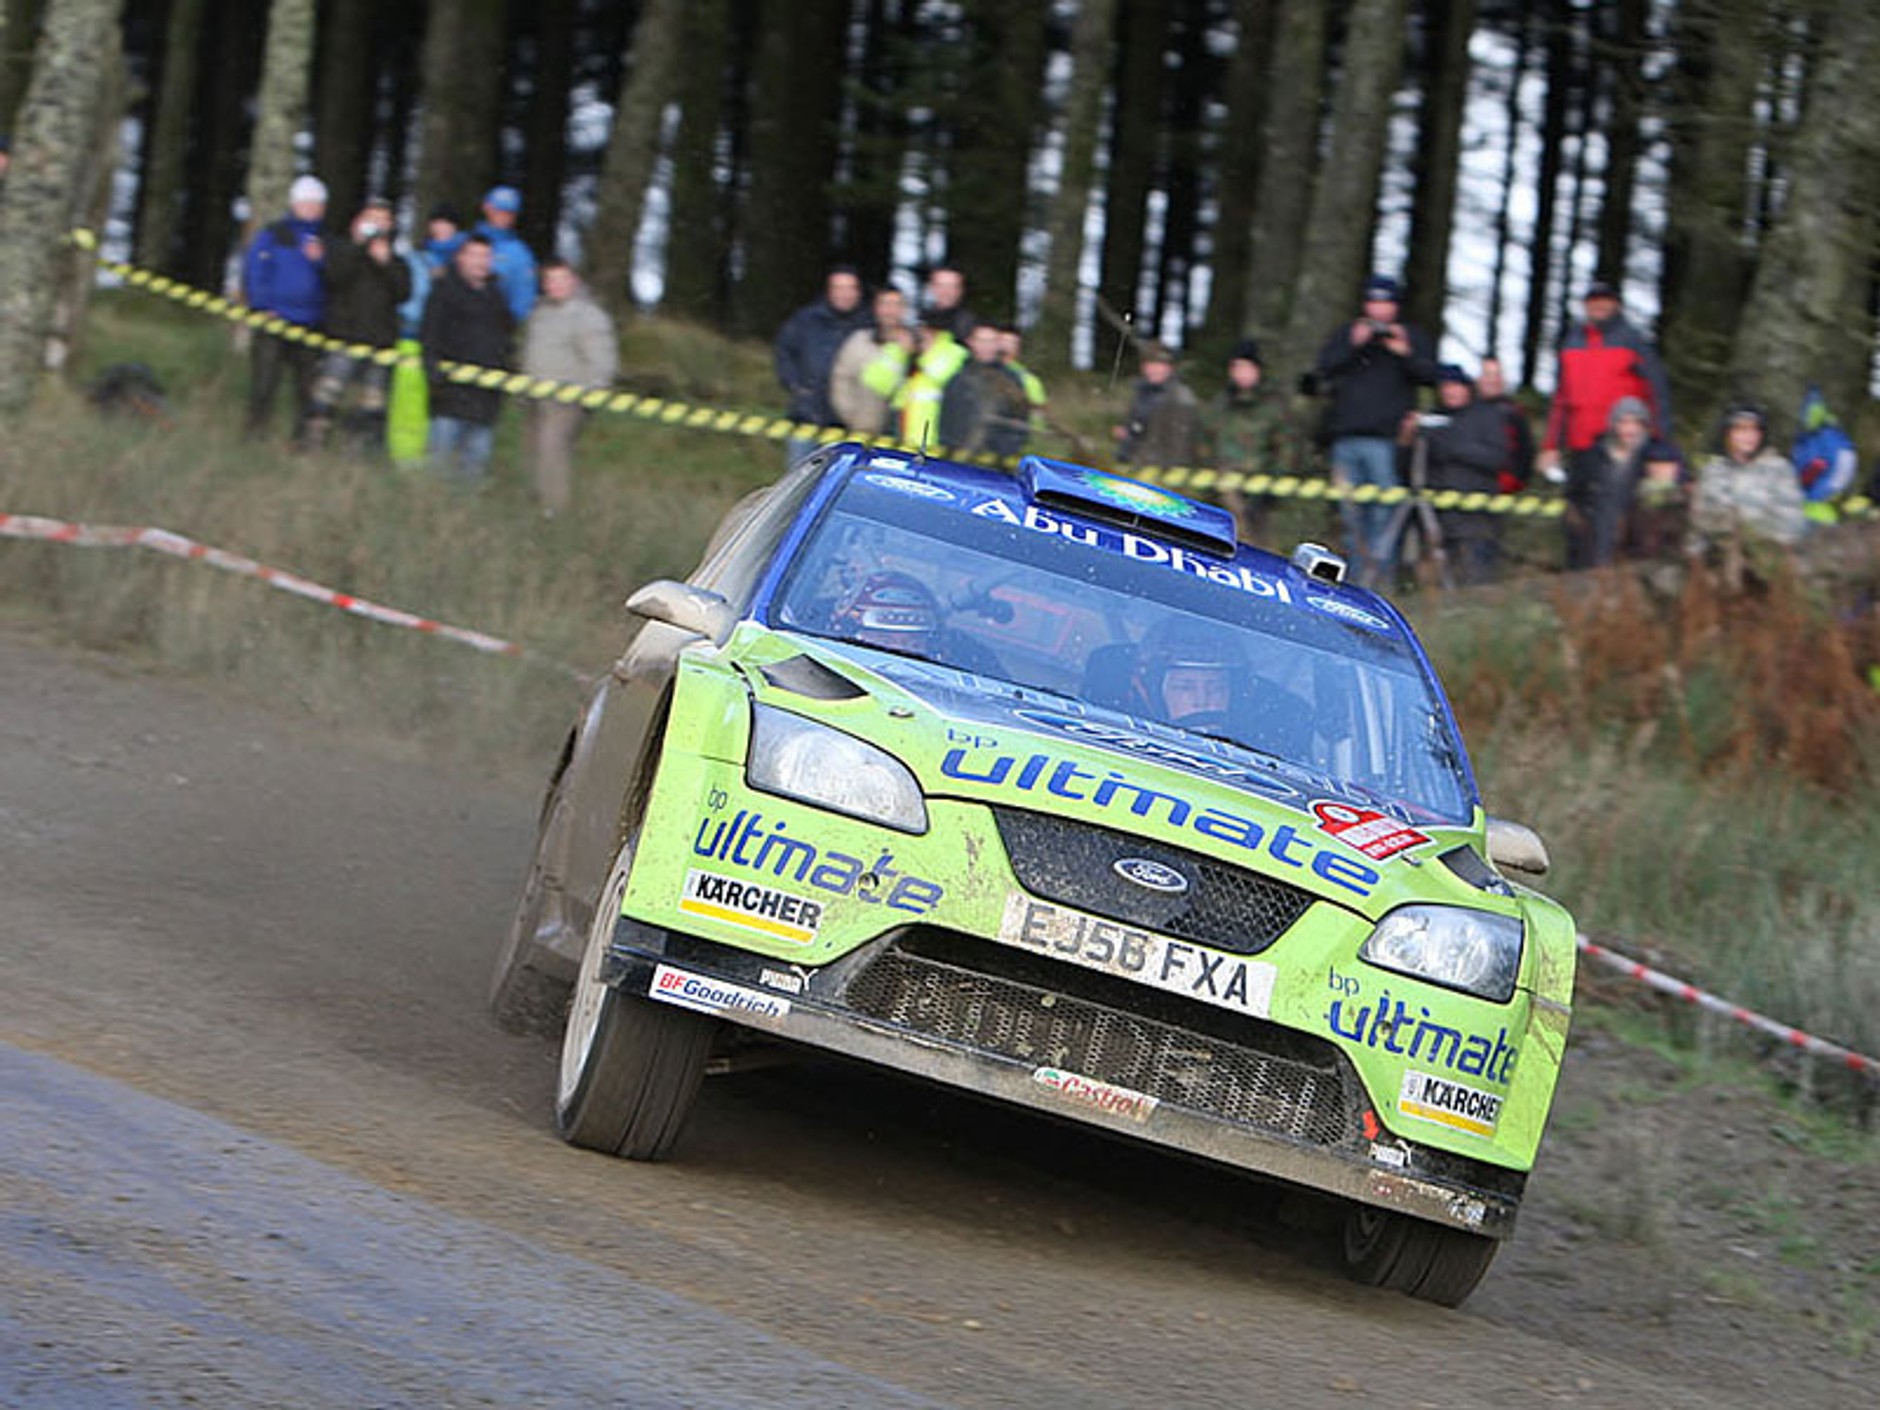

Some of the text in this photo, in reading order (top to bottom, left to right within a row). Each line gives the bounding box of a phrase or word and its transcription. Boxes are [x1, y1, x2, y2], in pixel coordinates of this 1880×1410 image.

[971, 498, 1098, 546] Abu
[946, 728, 998, 749] bp
[707, 785, 728, 813] bp
[940, 747, 1381, 897] ultimate
[693, 810, 944, 914] ultimate
[695, 873, 822, 929] KÄRCHER
[1020, 902, 1249, 1007] EJ56 FXA
[658, 972, 780, 1018] BFGoodrich
[1328, 965, 1360, 996] bp
[1422, 1076, 1502, 1122] KÄRCHE
